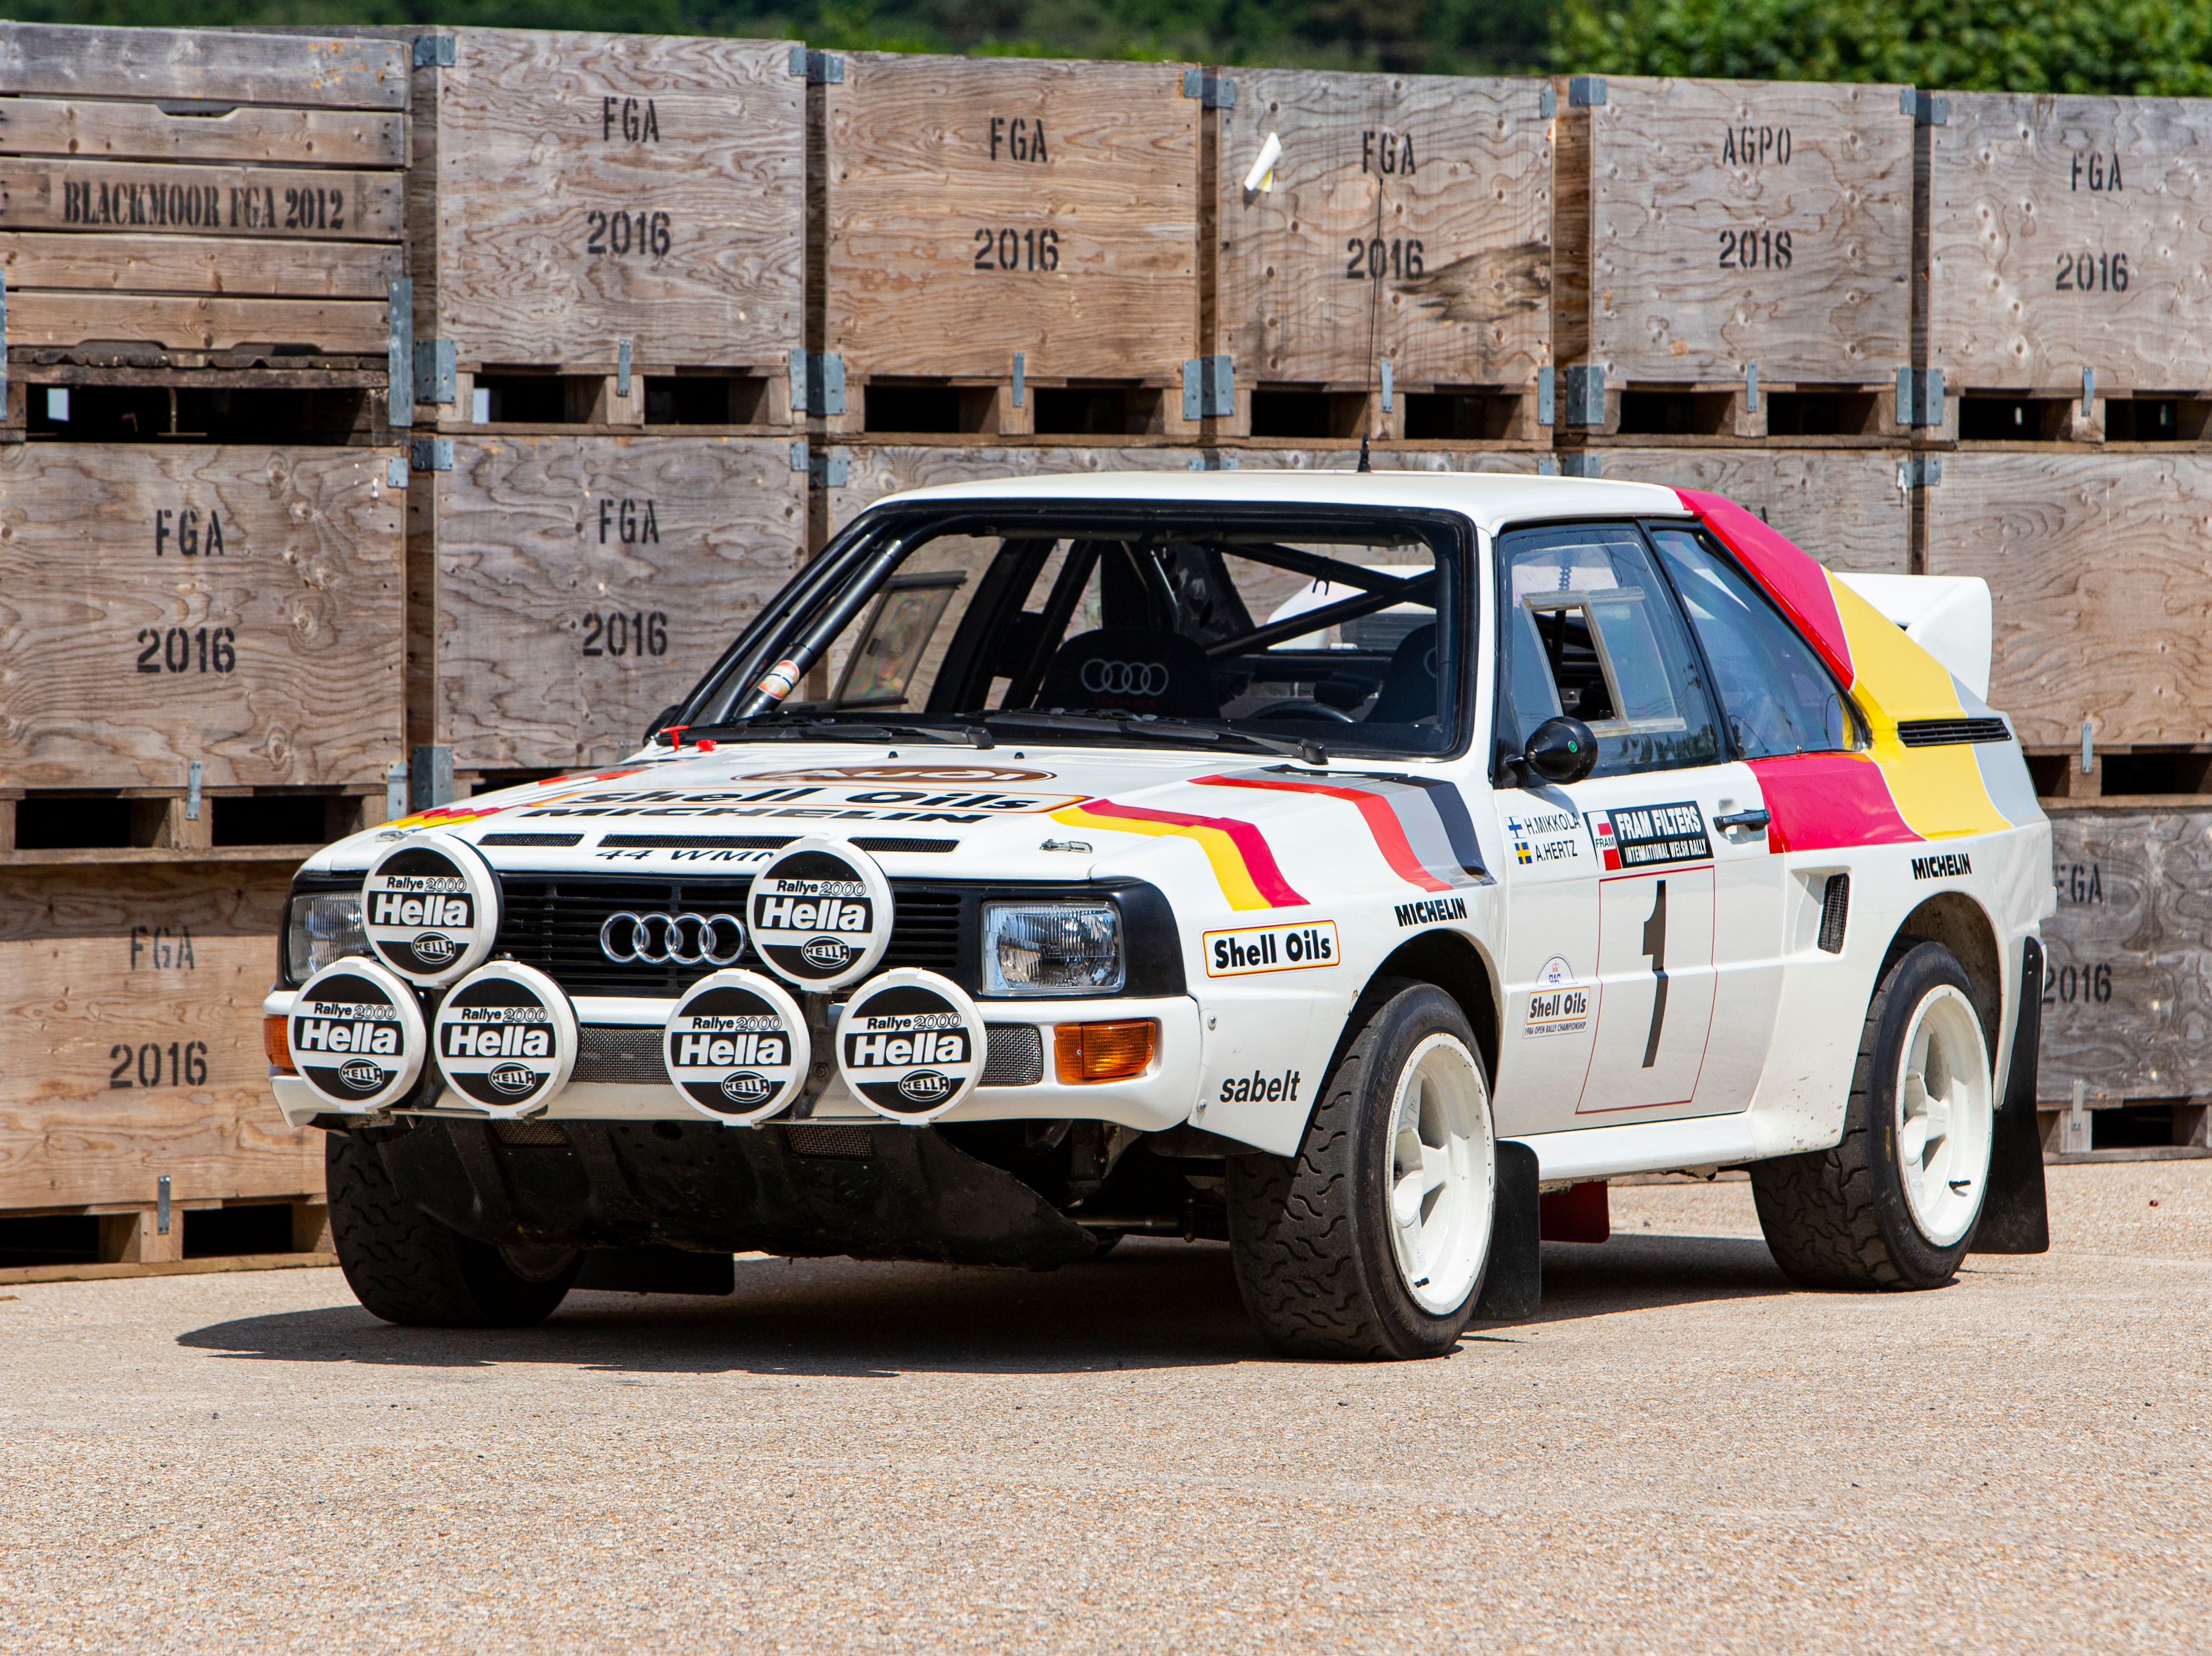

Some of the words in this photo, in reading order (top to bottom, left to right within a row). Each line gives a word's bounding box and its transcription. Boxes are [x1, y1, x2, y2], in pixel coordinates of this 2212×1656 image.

[603, 96, 660, 143] FGA
[990, 117, 1047, 163] FGA
[1363, 131, 1417, 175] FGA
[2071, 151, 2123, 191] FGA
[63, 181, 221, 227] BLACKMOOR
[231, 187, 276, 229] FGA
[285, 188, 345, 230] 2012
[587, 210, 671, 256] 2016
[974, 228, 1059, 271] 2016
[1346, 238, 1425, 281] 2016
[1719, 229, 1792, 270] 2018
[2056, 252, 2129, 293] 2016
[156, 509, 225, 557] FGA
[599, 499, 659, 545] FGA
[582, 611, 668, 657] 2016
[136, 627, 236, 674] 2016
[561, 787, 828, 804] Shell
[845, 791, 1040, 810] Oils
[516, 807, 994, 824] MICHELIN
[1524, 812, 1581, 836] H.MIKKOLA
[1615, 811, 1654, 841] FRAM
[1651, 805, 1702, 836] FILTERS
[595, 849, 654, 860] 44
[1534, 840, 1578, 862] A.HERTZ
[1595, 837, 1616, 849] FRAM
[1624, 842, 1670, 863] INTERNATIONAL
[1668, 839, 1690, 858] WELSH
[1689, 838, 1707, 856] RALLY
[1911, 853, 1973, 880] MICHELIN
[386, 876, 424, 891] Rallye
[424, 877, 467, 892] 2000
[776, 880, 818, 895] Rallye
[819, 881, 866, 896] 2000
[374, 893, 468, 926] Hella
[761, 897, 867, 931] Hella
[1394, 897, 1468, 927] MICHELIN
[131, 925, 195, 970] FGA
[415, 940, 454, 954] HELLA
[805, 945, 850, 961] HELLA
[1214, 933, 1277, 969] Shell
[1285, 929, 1332, 962] Oils
[1642, 880, 1669, 1068] 1
[2042, 962, 2112, 1003] 2016
[314, 1002, 352, 1018] Rallye
[353, 1005, 397, 1020] 2000
[462, 1008, 502, 1022] Rallye
[503, 1007, 548, 1023] 2000
[1529, 994, 1561, 1019] Shell
[1564, 992, 1587, 1015] Oils
[301, 1019, 397, 1054] Hella
[692, 1017, 735, 1032] Rallye
[734, 1015, 783, 1031] 2000
[867, 1017, 912, 1031] Rallye
[913, 1013, 962, 1029] 2000
[1534, 1025, 1545, 1034] OPEN
[1546, 1023, 1557, 1033] RALLY
[1557, 1021, 1586, 1032] CHAMPIONSHIP
[448, 1025, 549, 1057] Hella
[679, 1033, 784, 1065] Hella
[853, 1032, 964, 1066] Hella
[110, 1040, 208, 1088] 2016
[343, 1067, 384, 1082] HELLA
[493, 1070, 535, 1084] HELLA
[726, 1079, 770, 1094] HELLA
[903, 1076, 950, 1093] HELLA
[1219, 1069, 1301, 1103] sabelt
